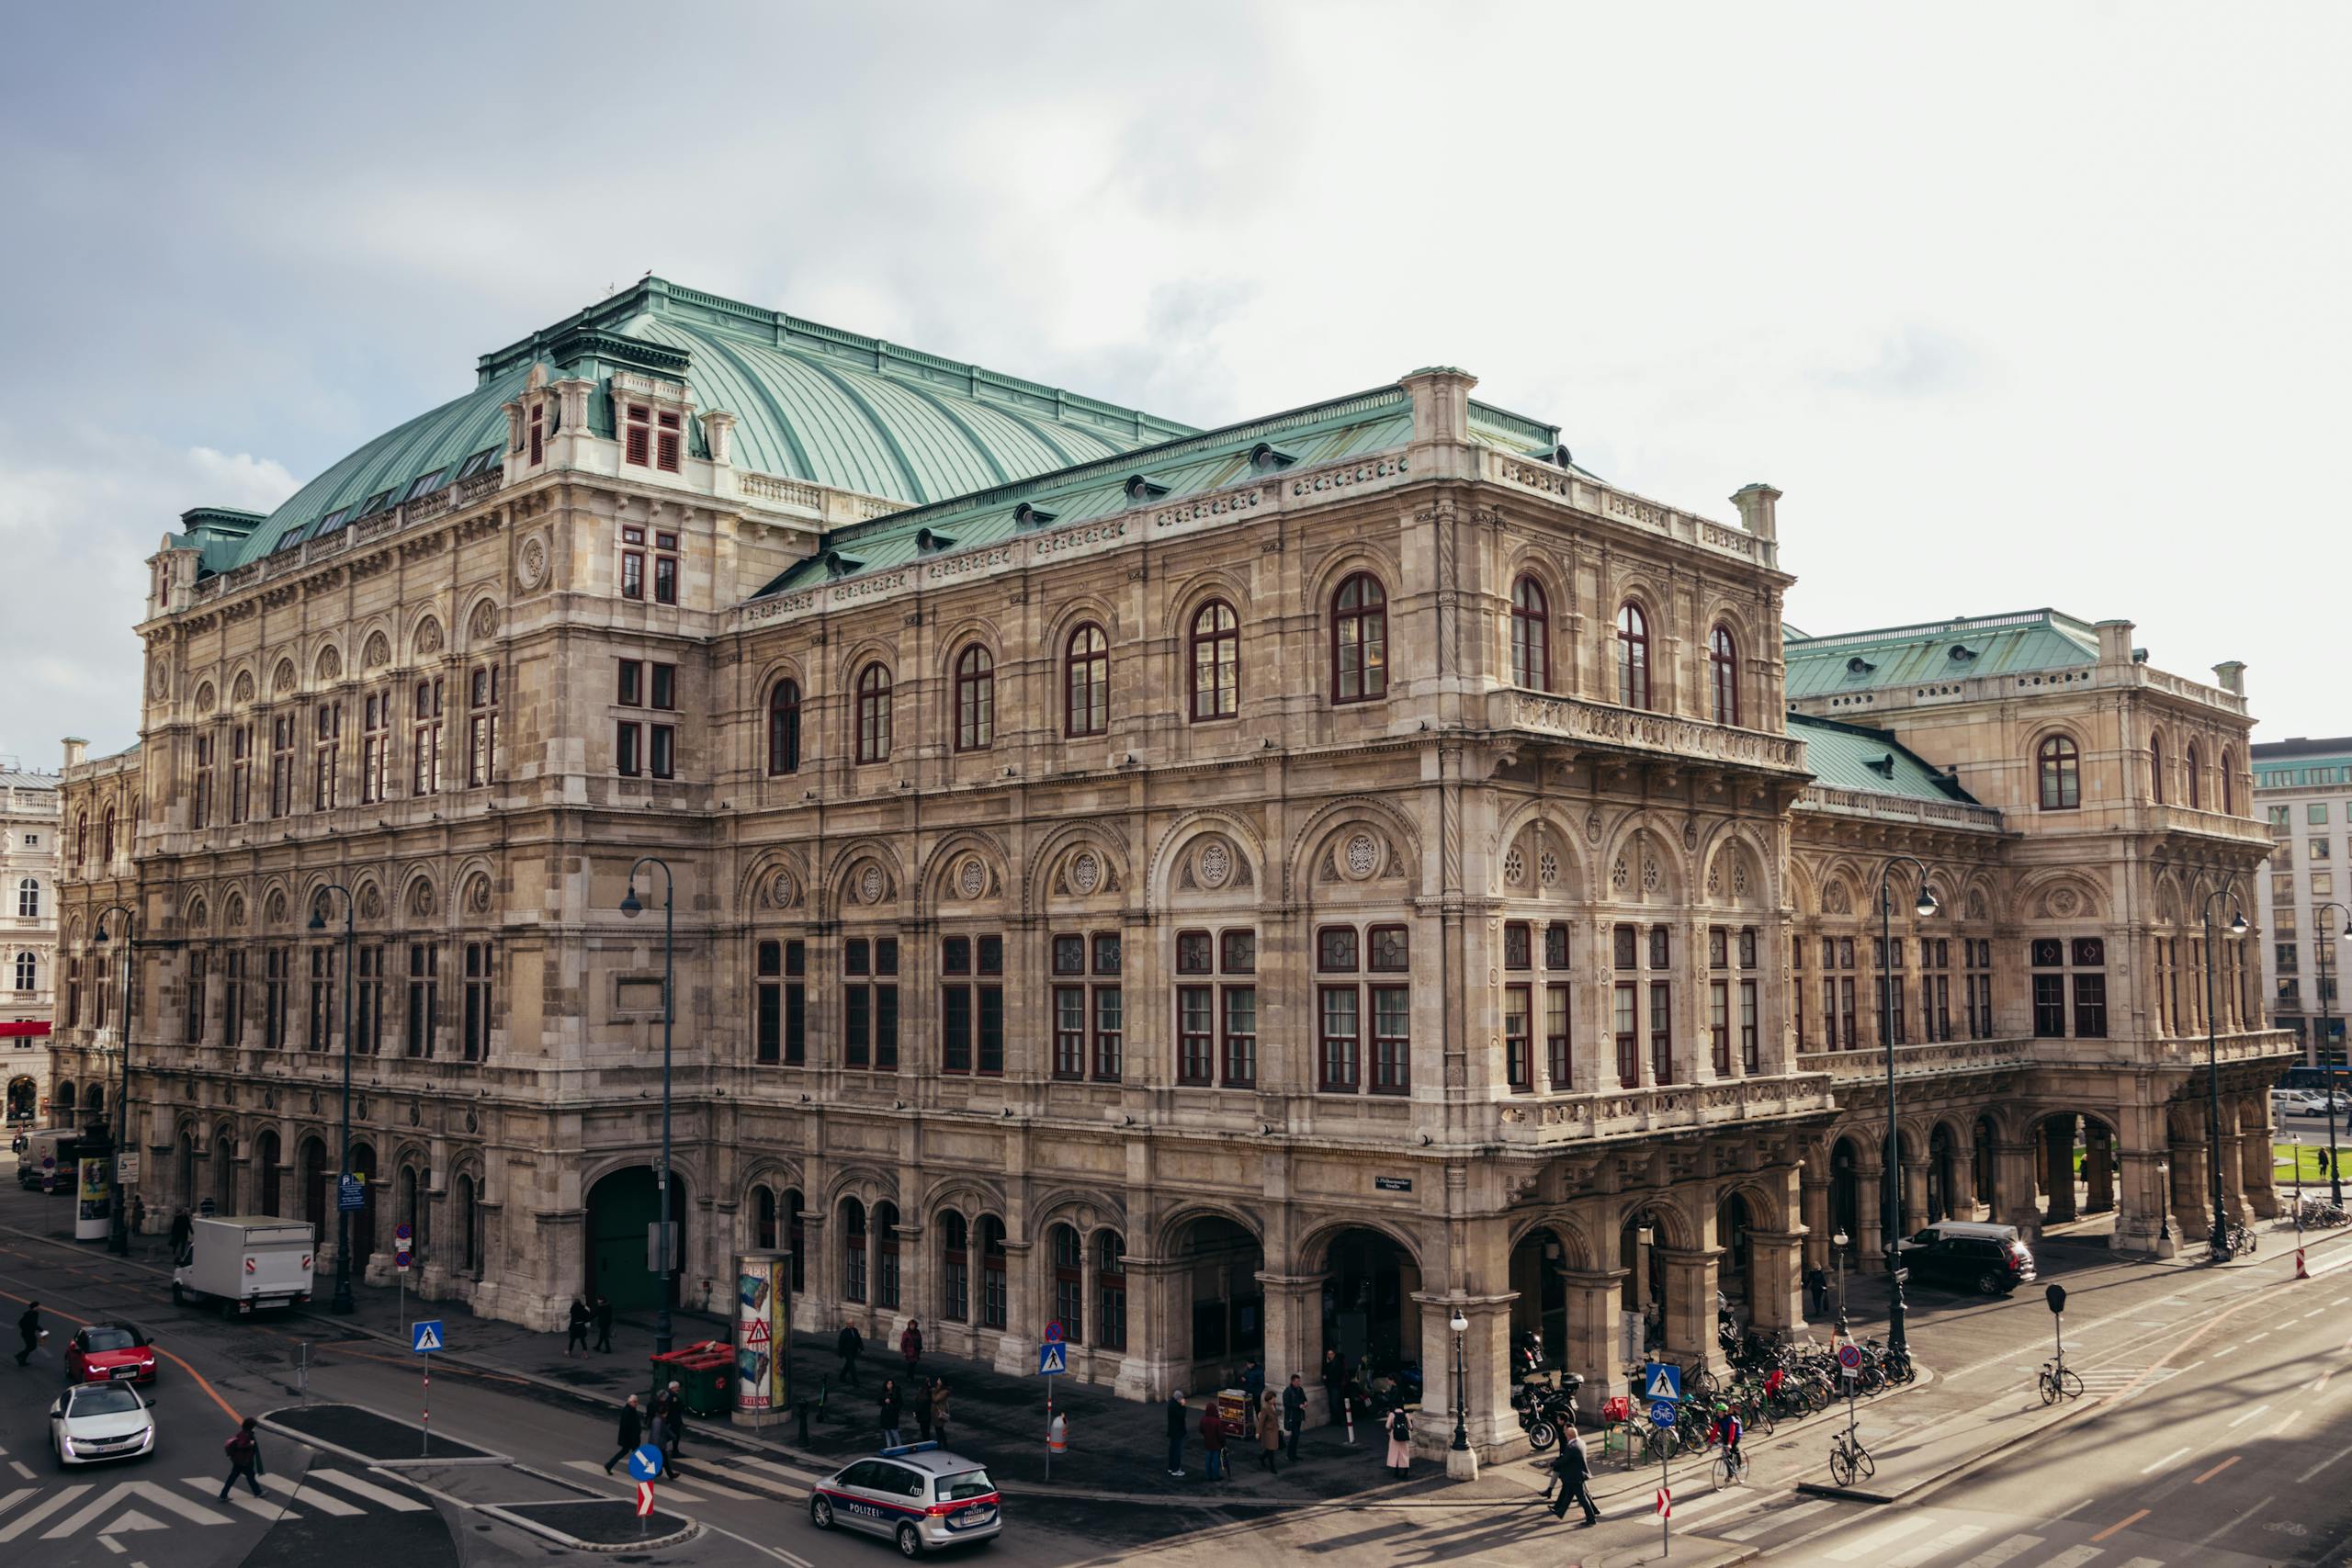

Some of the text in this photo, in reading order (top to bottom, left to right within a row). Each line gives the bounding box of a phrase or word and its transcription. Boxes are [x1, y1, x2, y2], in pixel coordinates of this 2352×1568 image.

[741, 1322, 768, 1330] ERTA
[913, 1487, 922, 1496] 133
[849, 1503, 879, 1517] POLIZEI
[964, 1507, 984, 1516] POLIZEI
